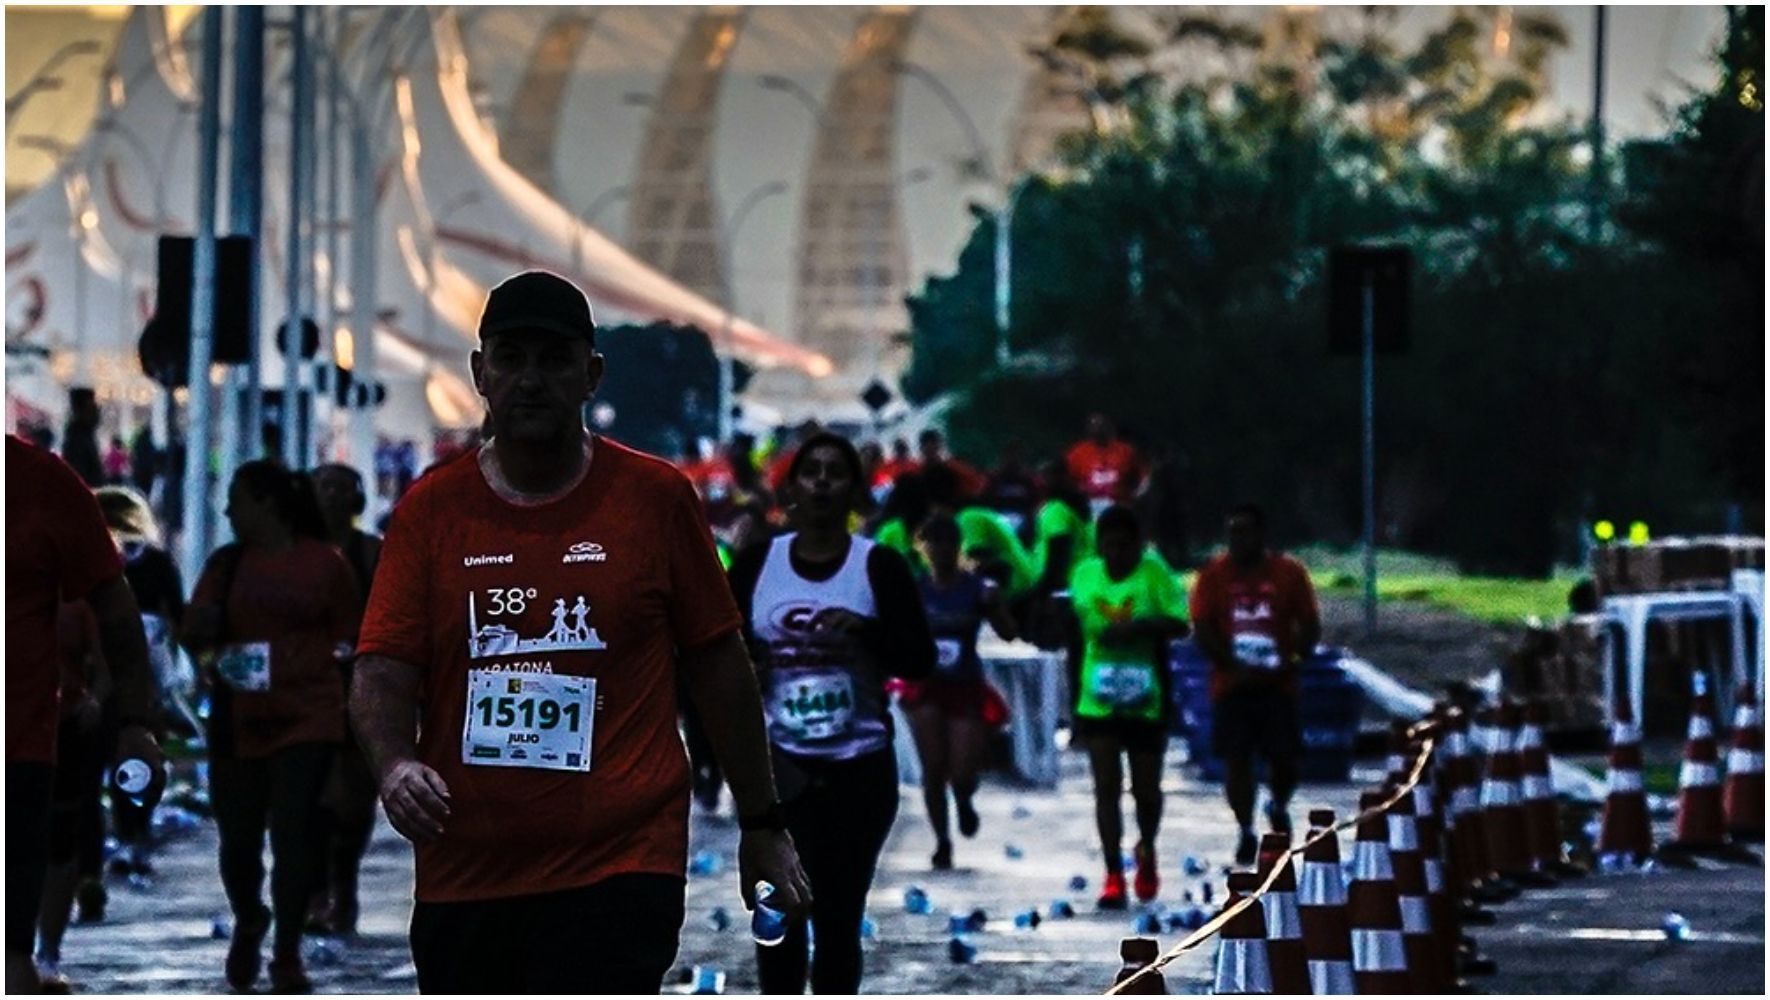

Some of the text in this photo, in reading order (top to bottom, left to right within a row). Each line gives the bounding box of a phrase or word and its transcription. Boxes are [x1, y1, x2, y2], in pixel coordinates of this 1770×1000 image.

[464, 553, 514, 567] Unimed
[479, 661, 554, 674] ARATONA
[476, 696, 581, 733] 15191
[506, 732, 540, 744] JULIO
